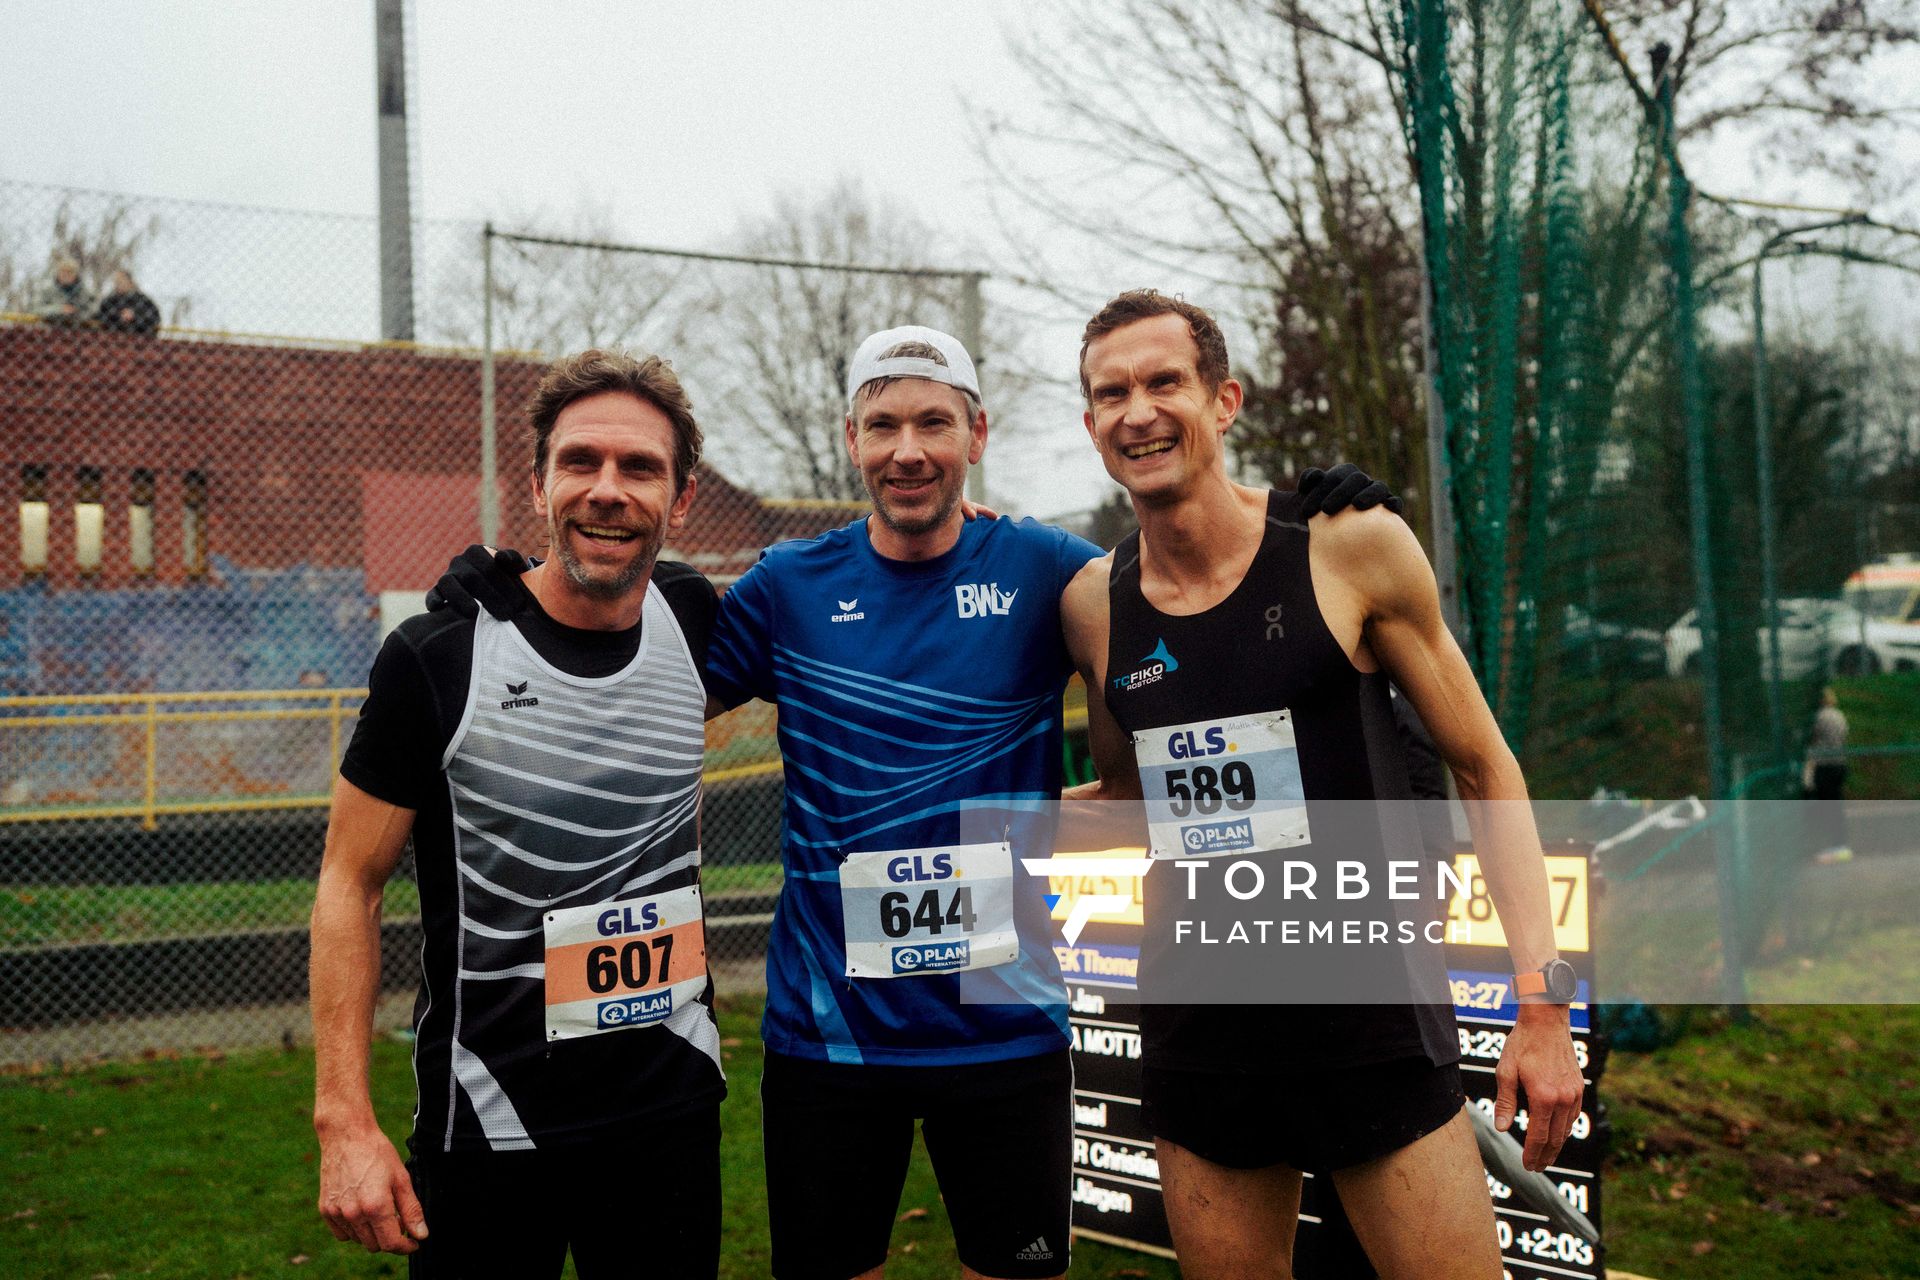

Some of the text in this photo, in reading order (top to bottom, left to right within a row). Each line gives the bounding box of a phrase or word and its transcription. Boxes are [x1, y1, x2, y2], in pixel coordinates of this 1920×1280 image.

[831, 611, 865, 623] erima
[1126, 674, 1163, 692] ROSTOCK
[501, 697, 539, 710] erima
[1165, 761, 1256, 818] 589
[1205, 824, 1249, 842] PLAN
[880, 886, 977, 938] 644
[924, 946, 967, 962] PLAN
[586, 933, 674, 994] 607
[630, 996, 670, 1015] PLAN
[1015, 1250, 1054, 1261] adidas
